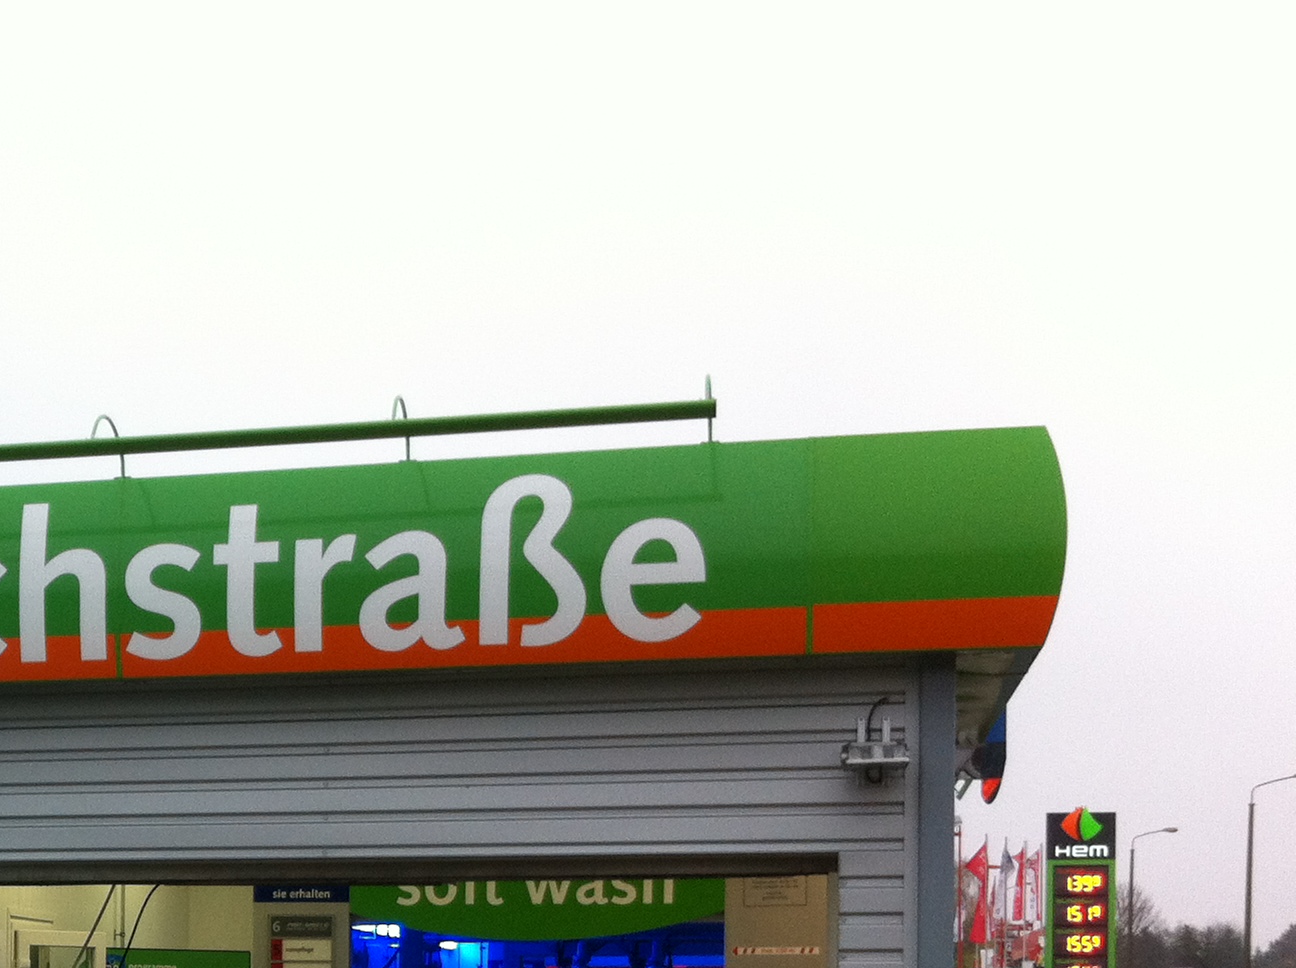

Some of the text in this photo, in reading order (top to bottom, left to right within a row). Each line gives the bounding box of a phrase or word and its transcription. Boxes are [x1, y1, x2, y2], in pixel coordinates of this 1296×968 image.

[273, 889, 330, 899] sie erhalten
[273, 921, 281, 932] 6
